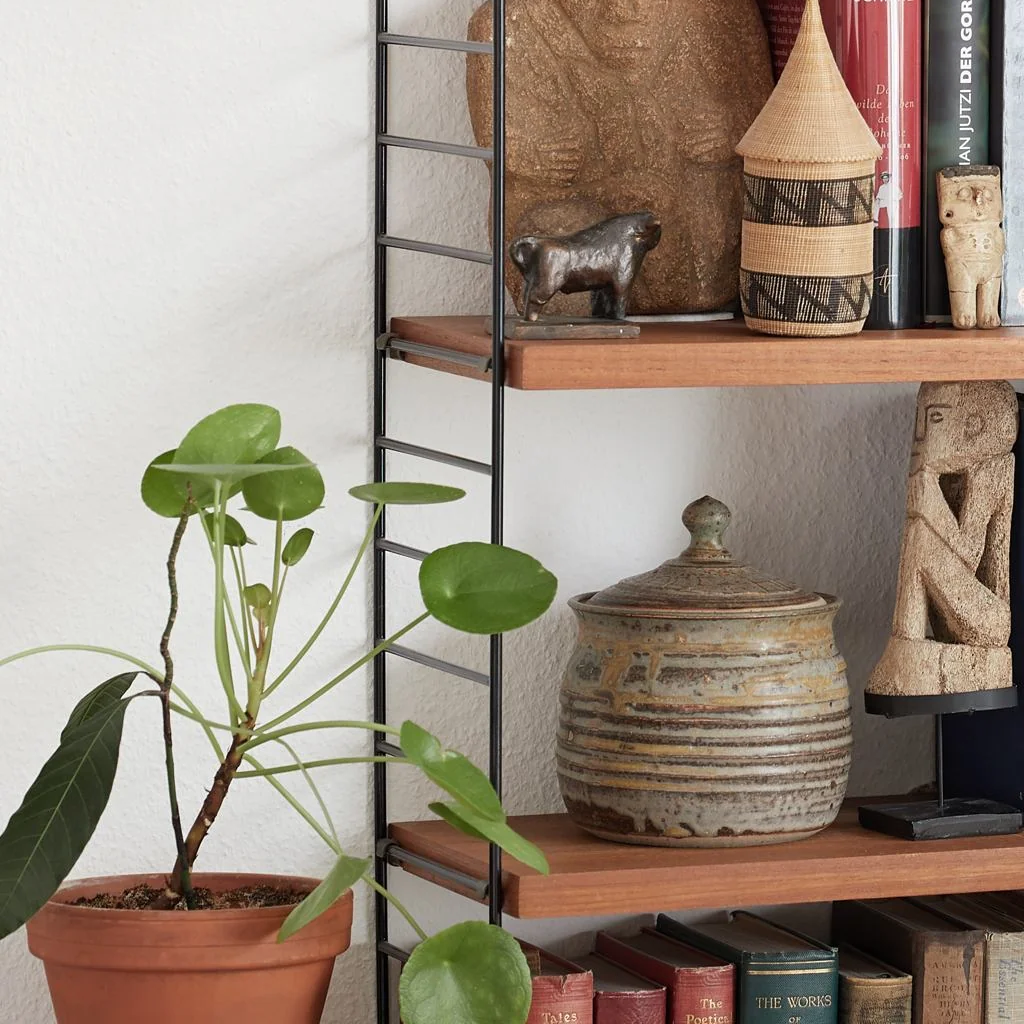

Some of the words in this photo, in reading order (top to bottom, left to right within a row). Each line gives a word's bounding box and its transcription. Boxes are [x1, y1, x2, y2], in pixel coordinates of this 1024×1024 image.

[959, 45, 973, 84] DER
[959, 89, 975, 133] JUTZI
[700, 998, 723, 1009] The
[755, 996, 782, 1008] THE
[787, 994, 832, 1008] WORKS
[541, 1012, 578, 1024] Tales
